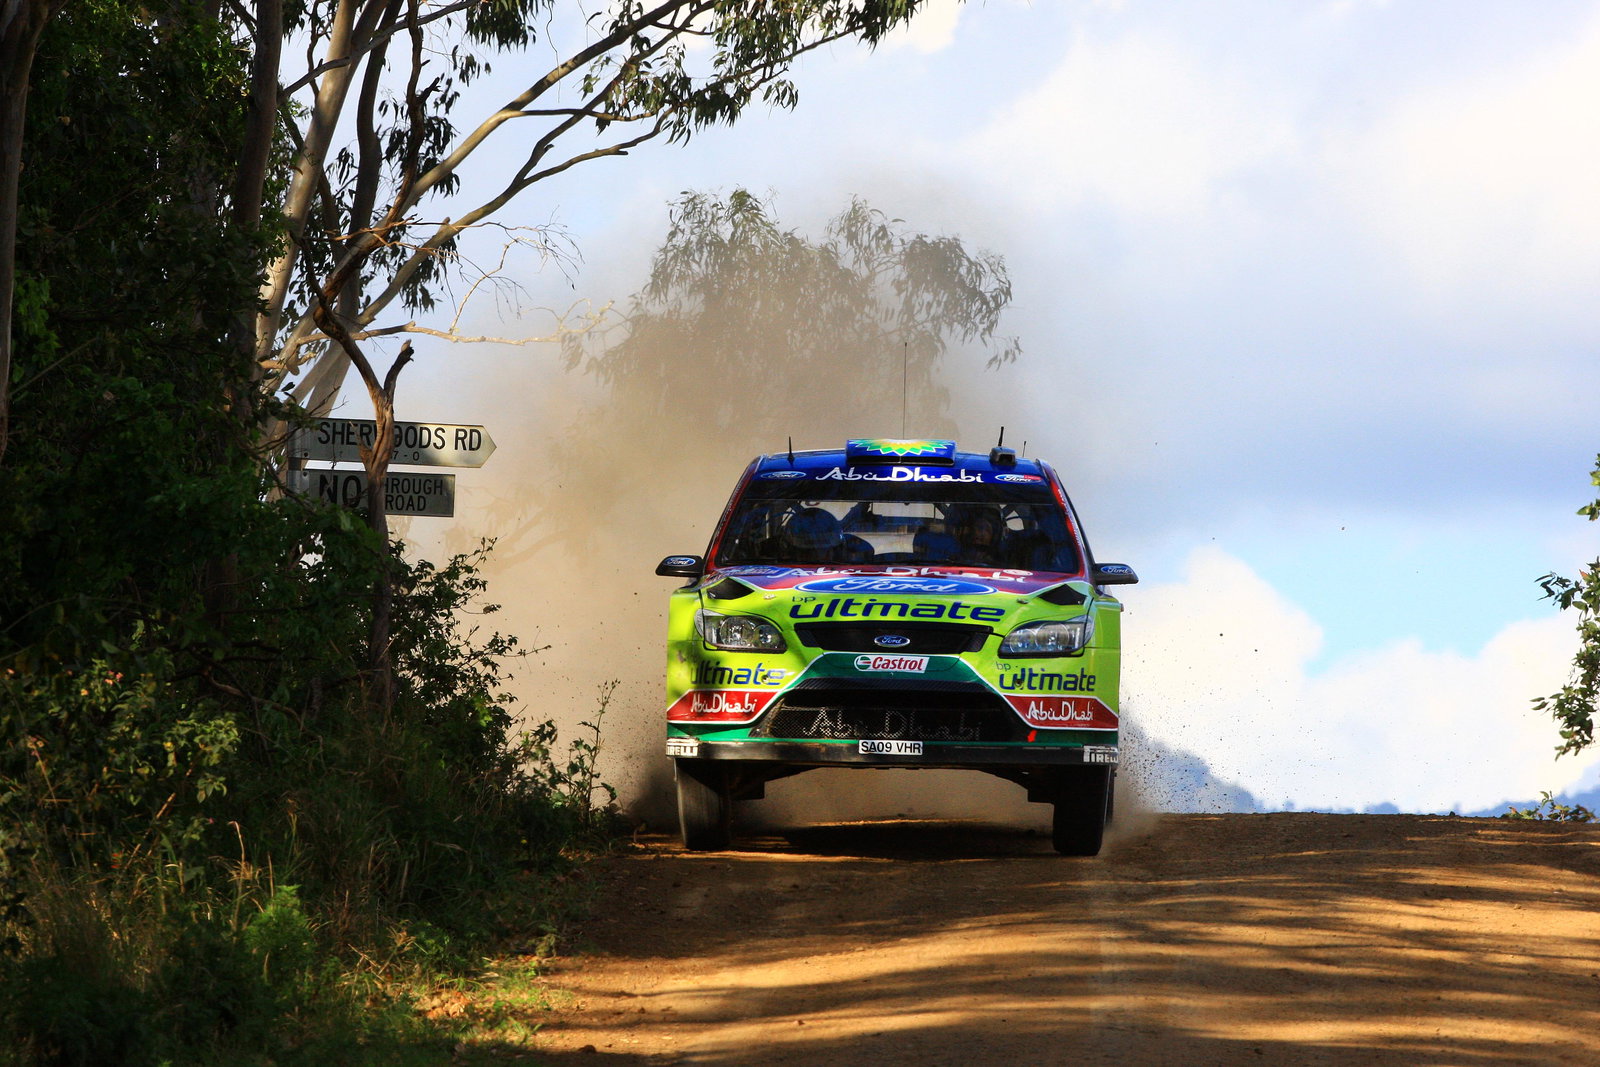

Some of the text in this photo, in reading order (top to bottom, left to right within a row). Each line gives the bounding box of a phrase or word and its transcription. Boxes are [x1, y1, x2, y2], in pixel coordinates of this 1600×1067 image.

[318, 421, 482, 451] SHEROODS RD
[815, 467, 984, 483] Abu Dhabi
[319, 474, 443, 507] NO HROUGH
[385, 495, 427, 512] ROAD
[767, 566, 877, 580] Abu
[1107, 566, 1129, 574] Ford
[832, 577, 956, 593] Ford
[789, 598, 1006, 622] ultimate
[881, 635, 903, 645] Ford
[872, 656, 924, 671] Castrol
[996, 661, 1011, 671] bp
[999, 667, 1096, 692] ultimate
[691, 692, 757, 713] Abu Dhabi
[1026, 700, 1094, 721] Abu Dhabi
[860, 740, 922, 754] SA09 VHR
